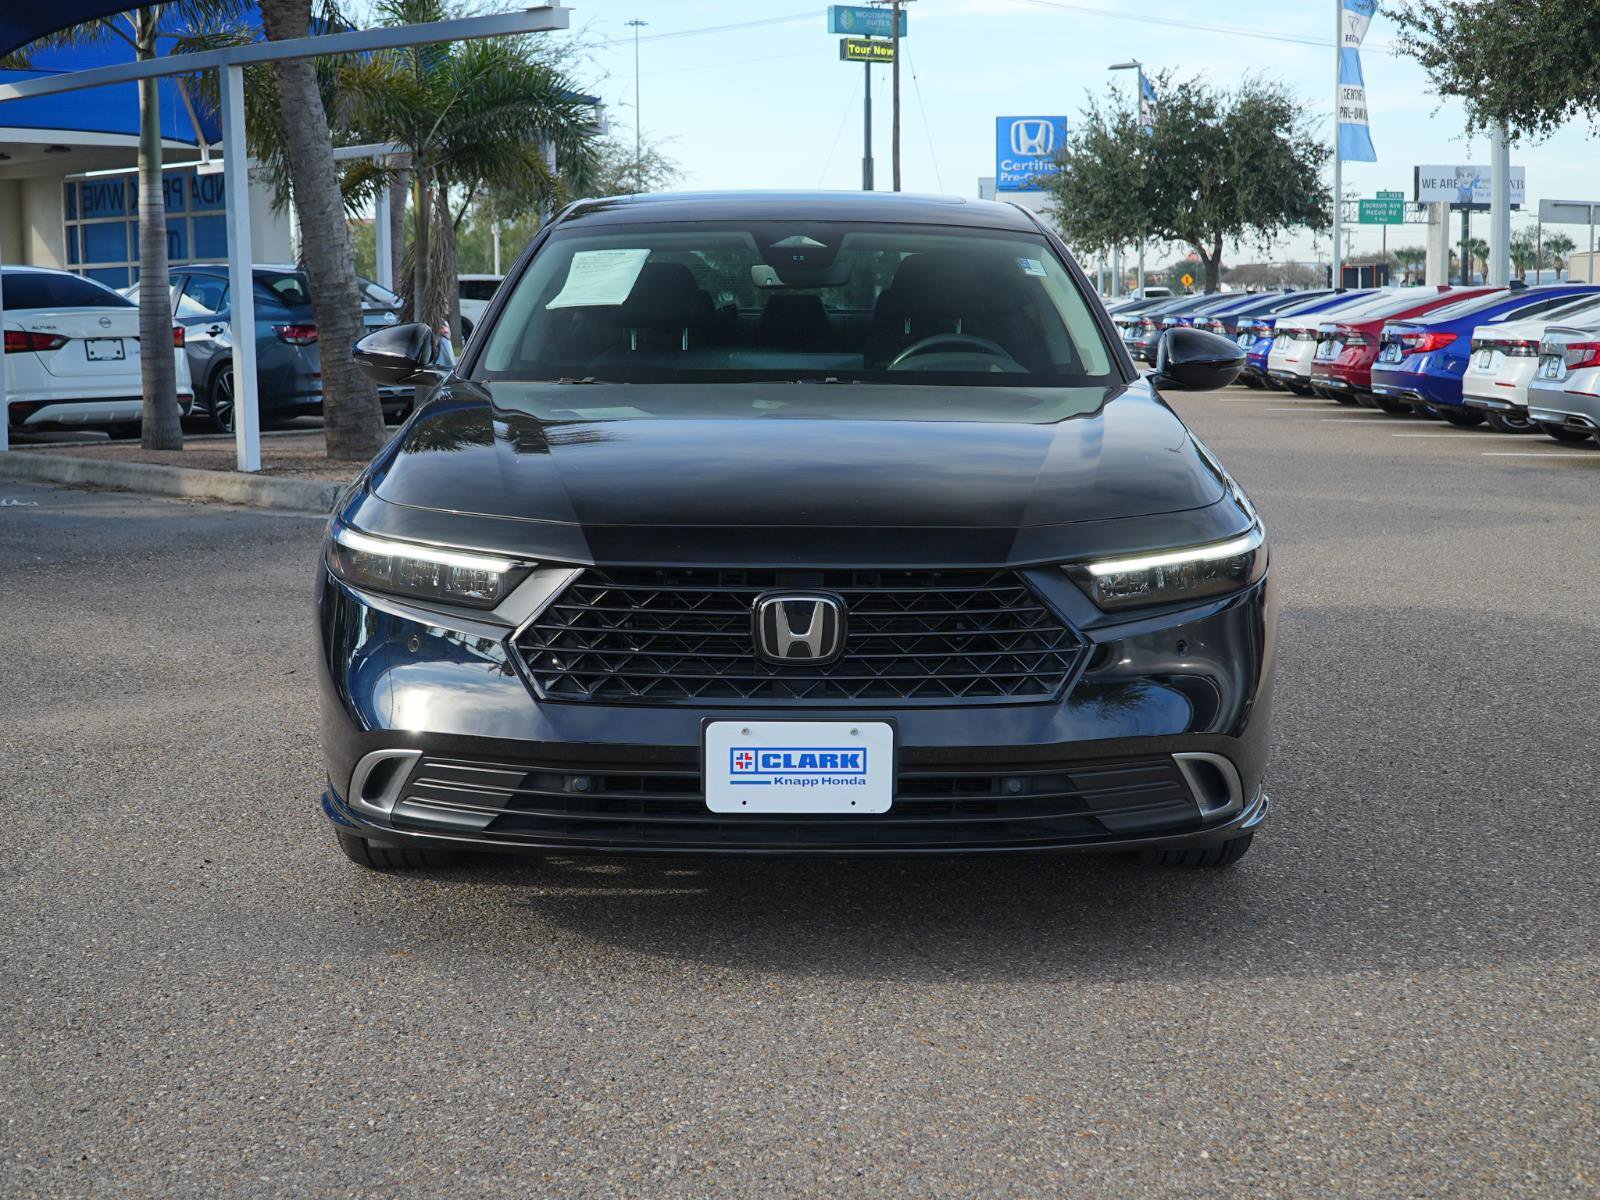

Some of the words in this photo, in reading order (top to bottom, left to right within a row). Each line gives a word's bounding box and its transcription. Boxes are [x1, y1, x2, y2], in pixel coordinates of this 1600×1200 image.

[849, 44, 871, 54] Tour
[873, 45, 894, 56] Now
[1421, 179, 1438, 189] WE
[1439, 179, 1458, 189] ARE
[761, 753, 861, 769] CLARK
[773, 776, 819, 788] Knapp
[821, 776, 867, 786] Honda
